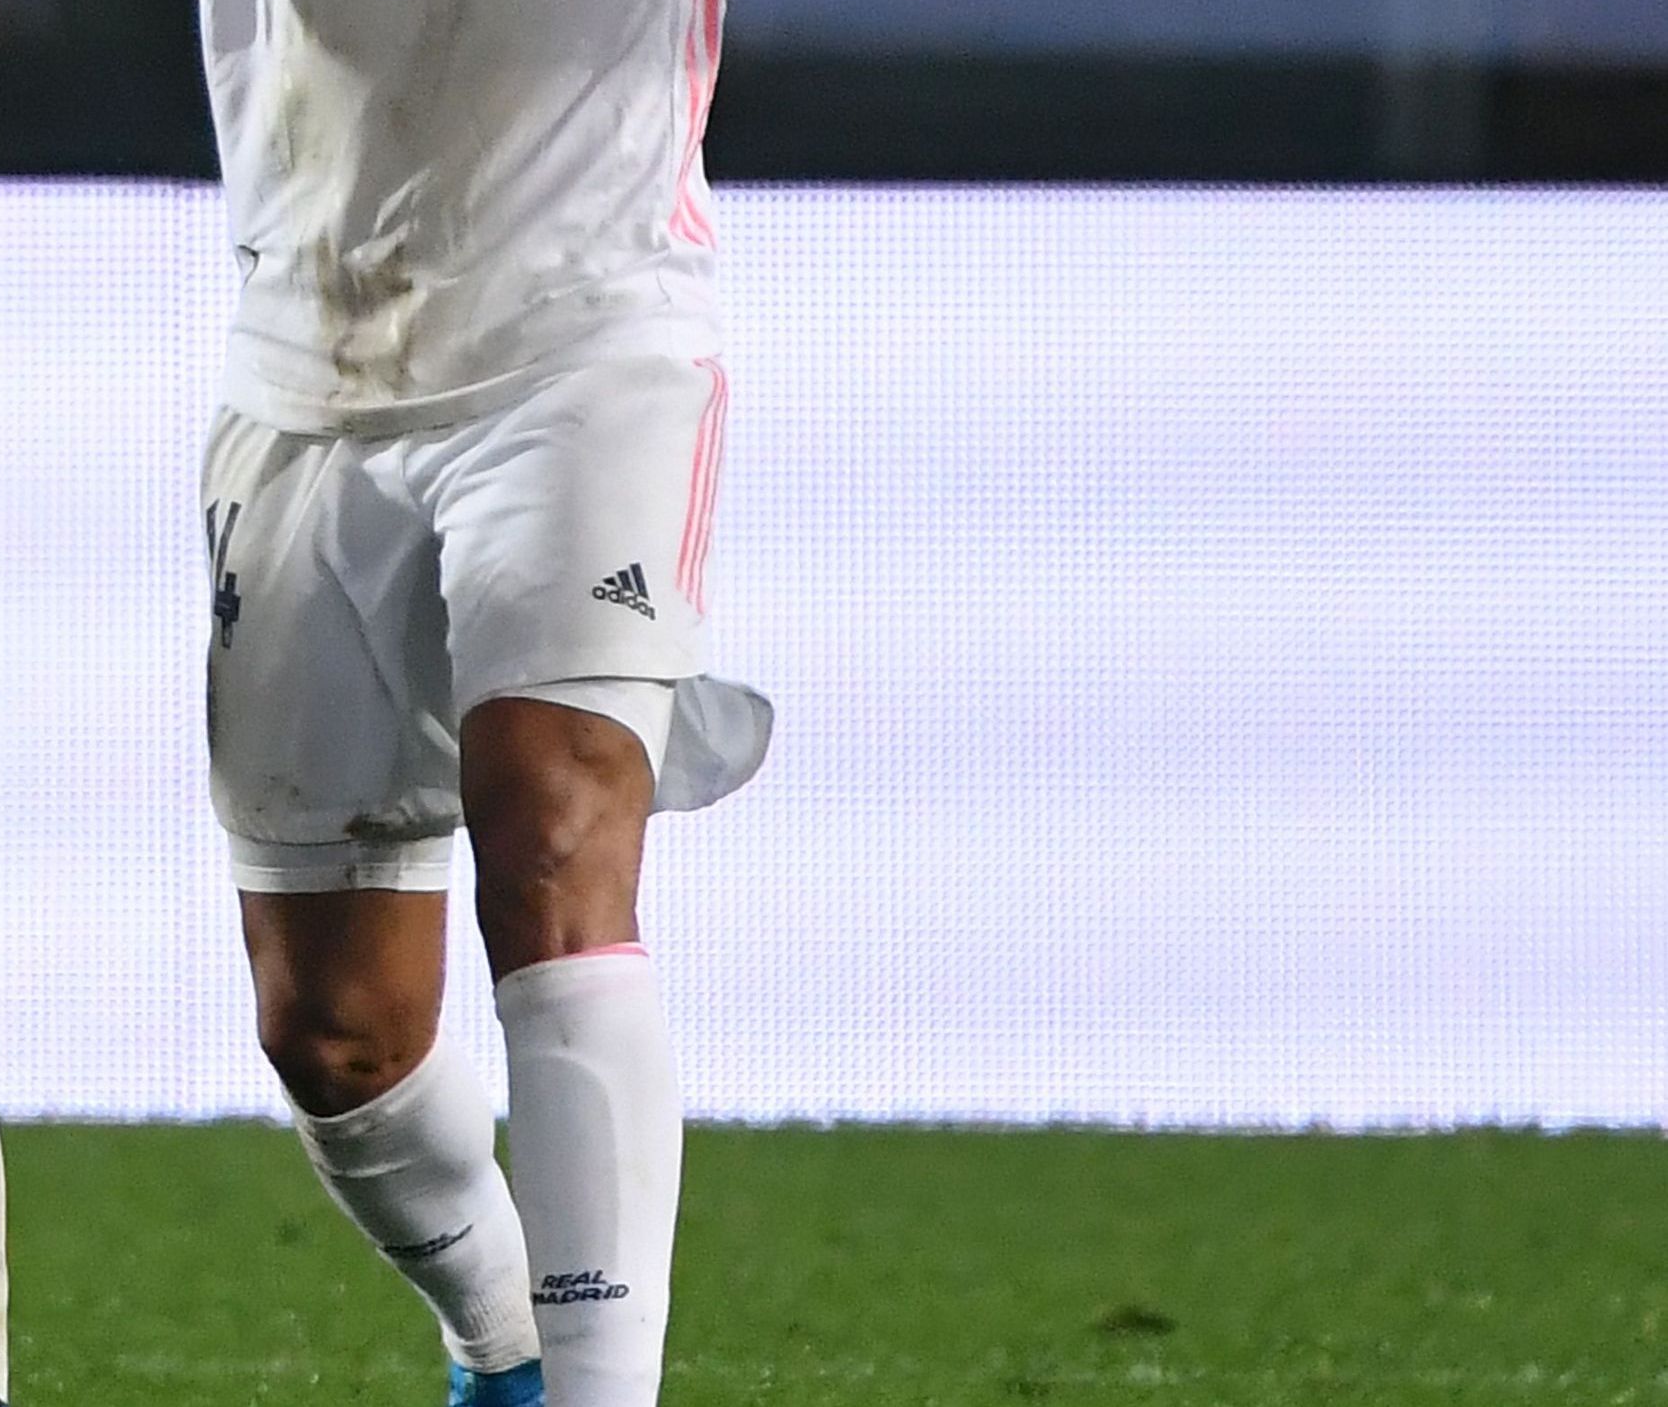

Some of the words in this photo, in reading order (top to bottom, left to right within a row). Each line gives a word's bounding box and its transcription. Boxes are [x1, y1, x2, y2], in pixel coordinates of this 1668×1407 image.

[591, 585, 656, 622] adidas
[540, 1269, 608, 1290] REAL
[531, 1283, 630, 1307] MADRID
